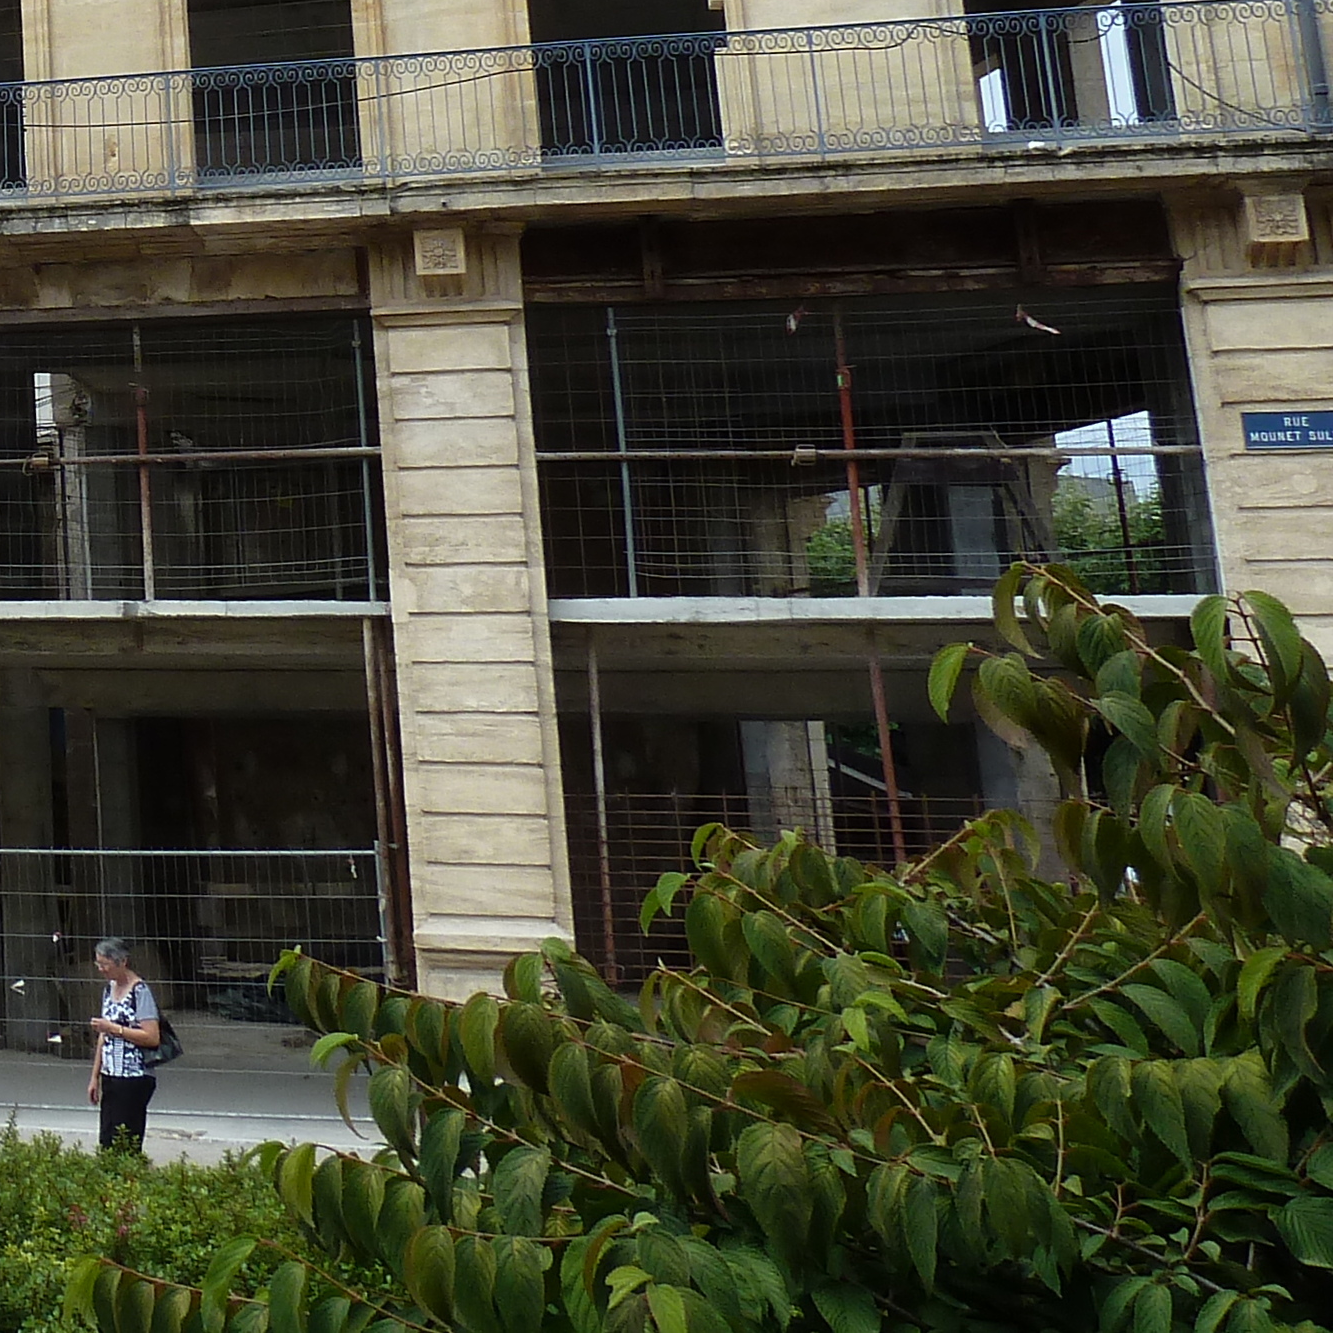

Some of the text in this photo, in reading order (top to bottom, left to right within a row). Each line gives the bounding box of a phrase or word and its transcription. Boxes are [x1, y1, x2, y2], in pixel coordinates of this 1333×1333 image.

[1283, 416, 1310, 427] RUE
[1249, 430, 1333, 442] MOUNET SUL
